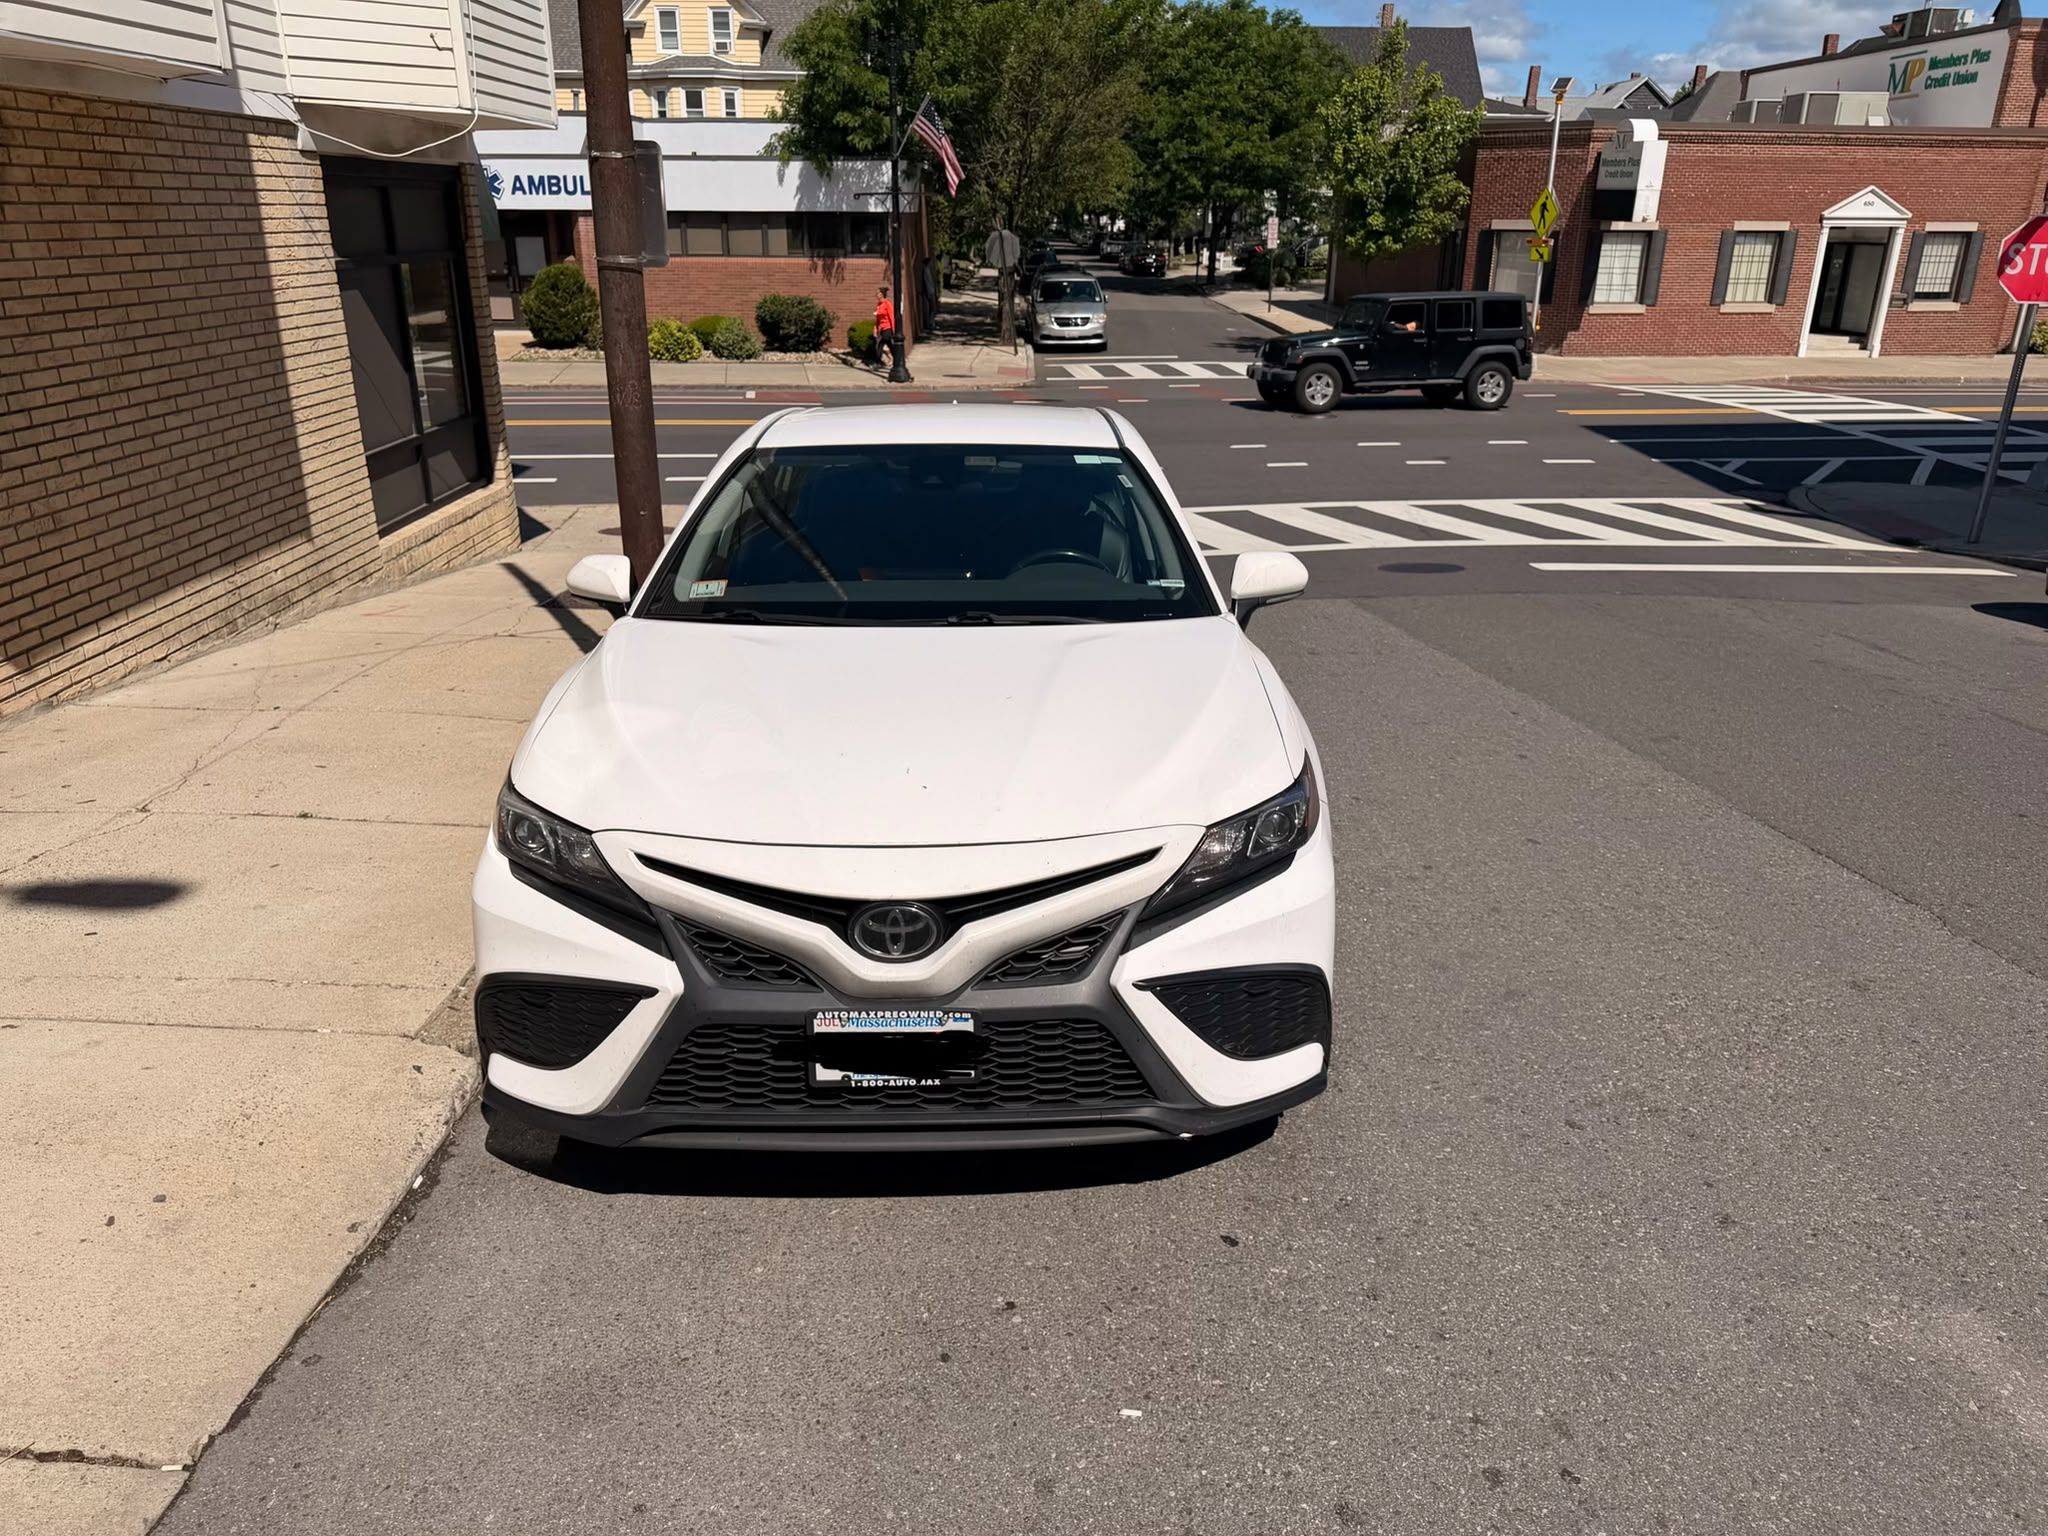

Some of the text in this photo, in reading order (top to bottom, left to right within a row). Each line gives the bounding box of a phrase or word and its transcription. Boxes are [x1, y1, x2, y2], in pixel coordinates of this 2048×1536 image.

[1928, 48, 1991, 71] Members Plus
[1924, 70, 1979, 90] Credit Union
[511, 175, 591, 196] AMBUL
[2004, 243, 2048, 275] ST
[816, 1010, 972, 1019] AUTOMAXPREOWNED.com
[817, 1018, 839, 1027] JUL
